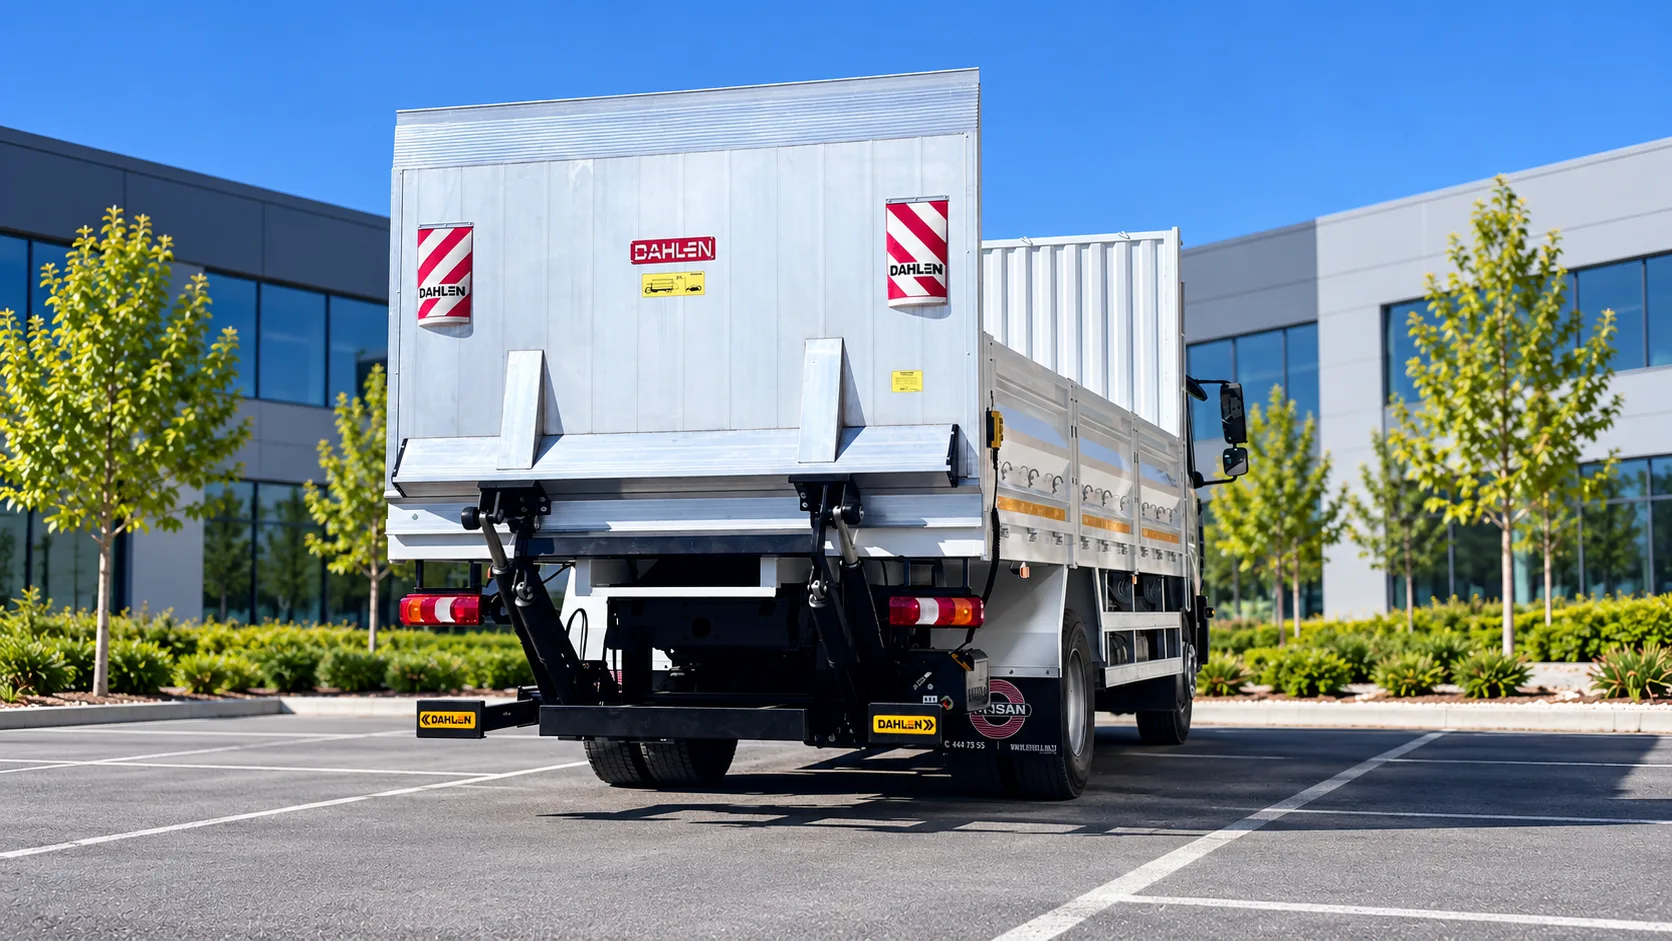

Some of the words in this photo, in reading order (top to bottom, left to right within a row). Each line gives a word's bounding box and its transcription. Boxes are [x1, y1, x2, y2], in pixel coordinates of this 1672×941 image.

[634, 240, 712, 261] DAHLEN
[890, 263, 943, 277] DAHLEN
[419, 285, 466, 299] DAHLEN
